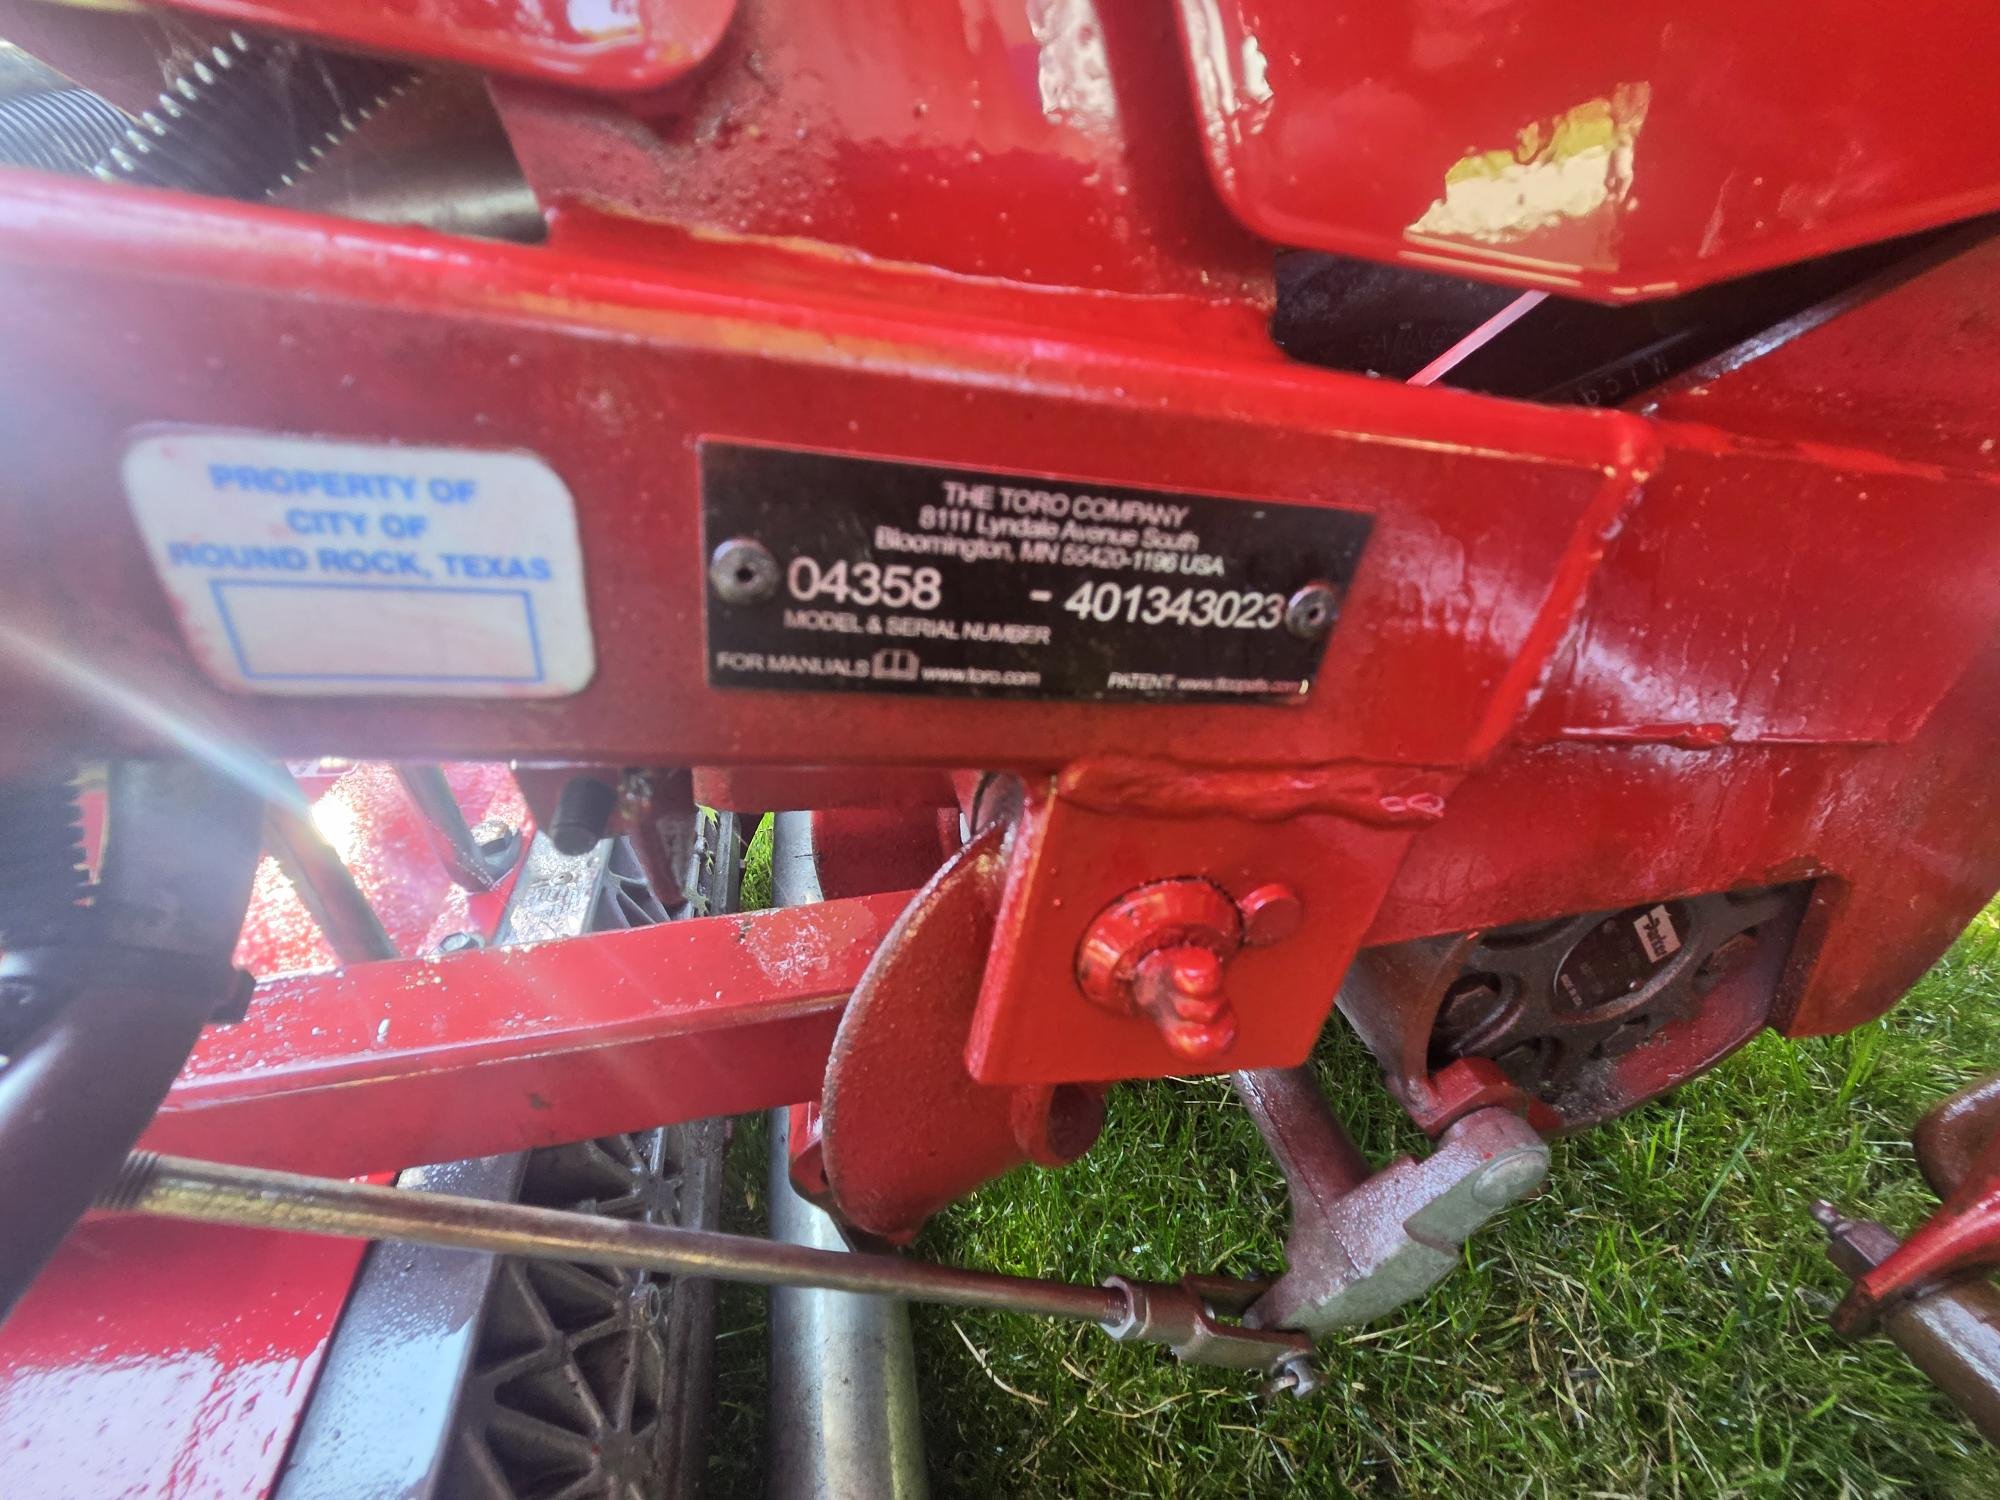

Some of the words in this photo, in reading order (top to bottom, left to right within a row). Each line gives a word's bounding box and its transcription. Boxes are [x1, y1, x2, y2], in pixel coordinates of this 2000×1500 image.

[209, 463, 416, 500] PROPERTY
[429, 479, 476, 503] OF
[286, 508, 366, 536] CITY
[381, 514, 428, 538] OF
[942, 481, 994, 510] THE
[999, 486, 1070, 517] TORO
[1072, 495, 1189, 527] COMPANY
[919, 504, 971, 532] 8111
[976, 511, 1060, 541] Lyndale
[1060, 519, 1139, 547] Avenue
[1141, 526, 1199, 551] South
[168, 542, 308, 571] ROUND
[318, 548, 432, 578] ROCK,
[440, 553, 551, 581] TEXAS
[875, 525, 1015, 562] Bloomington,
[1019, 539, 1060, 564] MN
[1179, 552, 1226, 578] USA
[788, 556, 942, 610] 04358
[1064, 581, 1285, 629] 401343023
[783, 608, 864, 634] MODEL
[865, 614, 882, 634] &
[886, 615, 960, 640] SERIAL
[962, 621, 1051, 645] NUMBER
[716, 651, 765, 673] FOR
[766, 654, 870, 678] MANUALS
[922, 666, 1041, 686] www.toro.com
